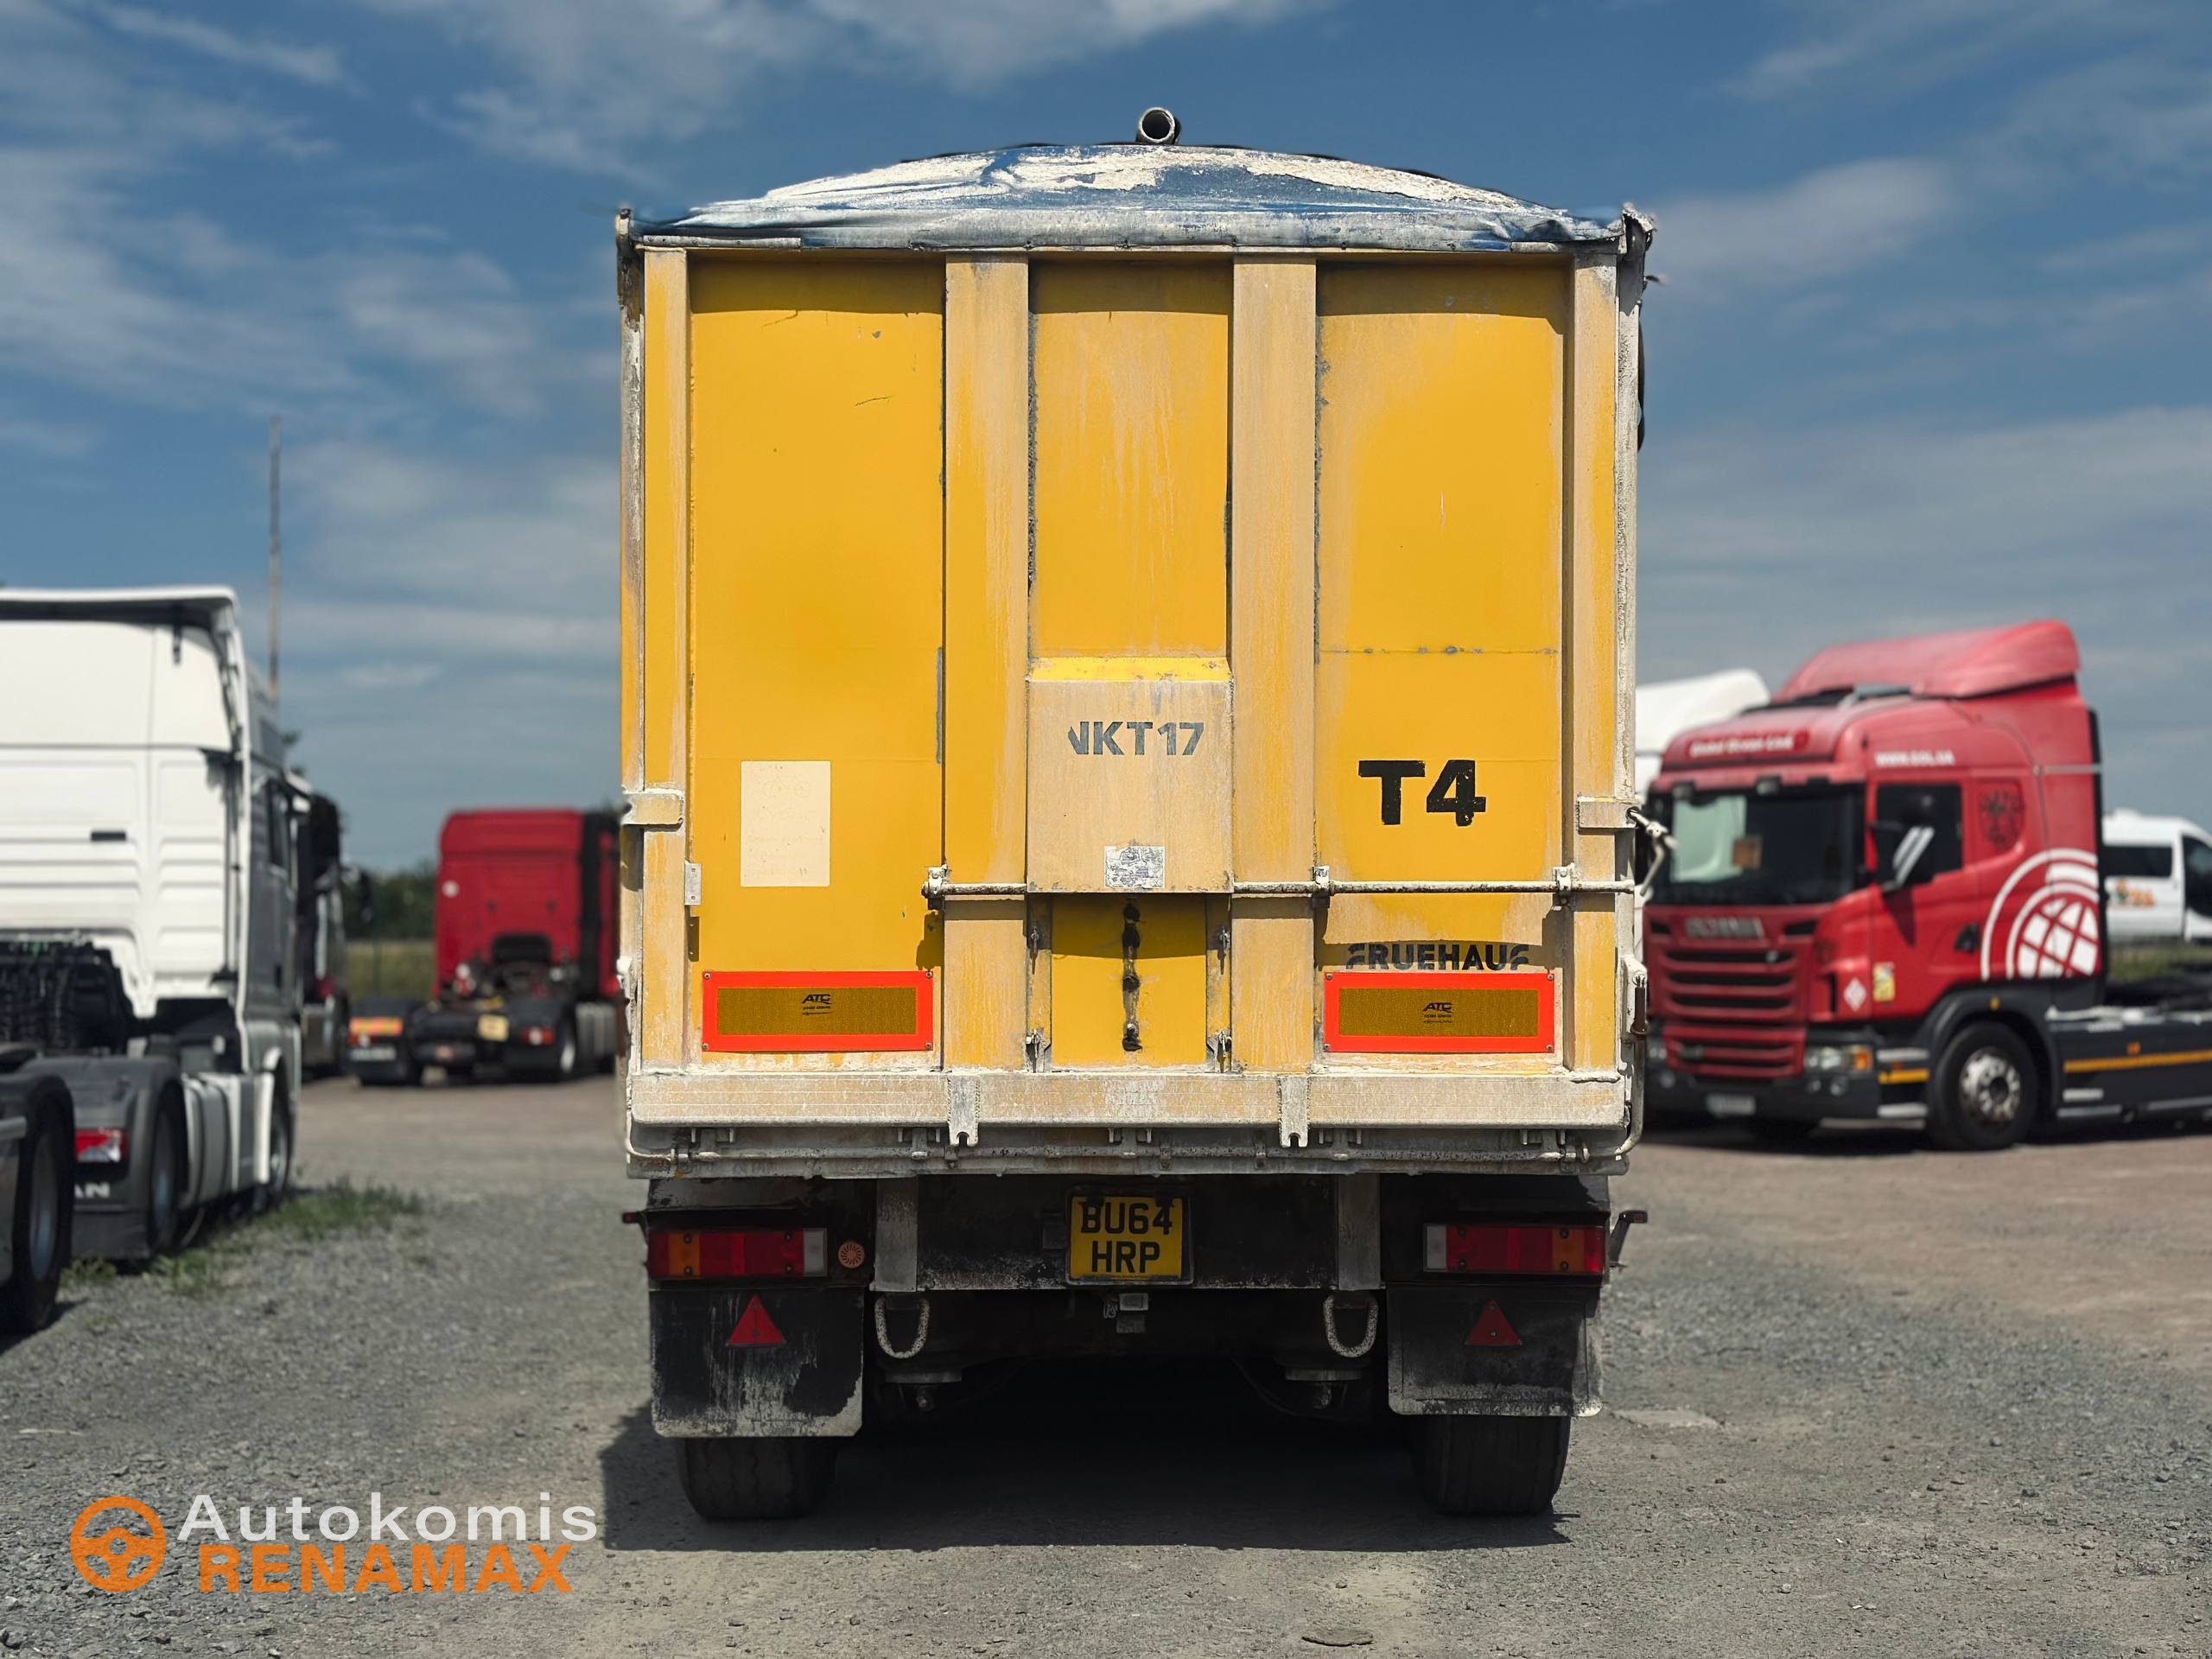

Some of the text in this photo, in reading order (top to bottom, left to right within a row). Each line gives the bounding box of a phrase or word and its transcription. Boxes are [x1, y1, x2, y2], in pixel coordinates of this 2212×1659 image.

[1358, 760, 1486, 827] T4
[1345, 943, 1529, 971] FRUEHAUF
[73, 1182, 111, 1198] AN
[1079, 1201, 1173, 1236] BU64
[1090, 1241, 1161, 1274] HRP
